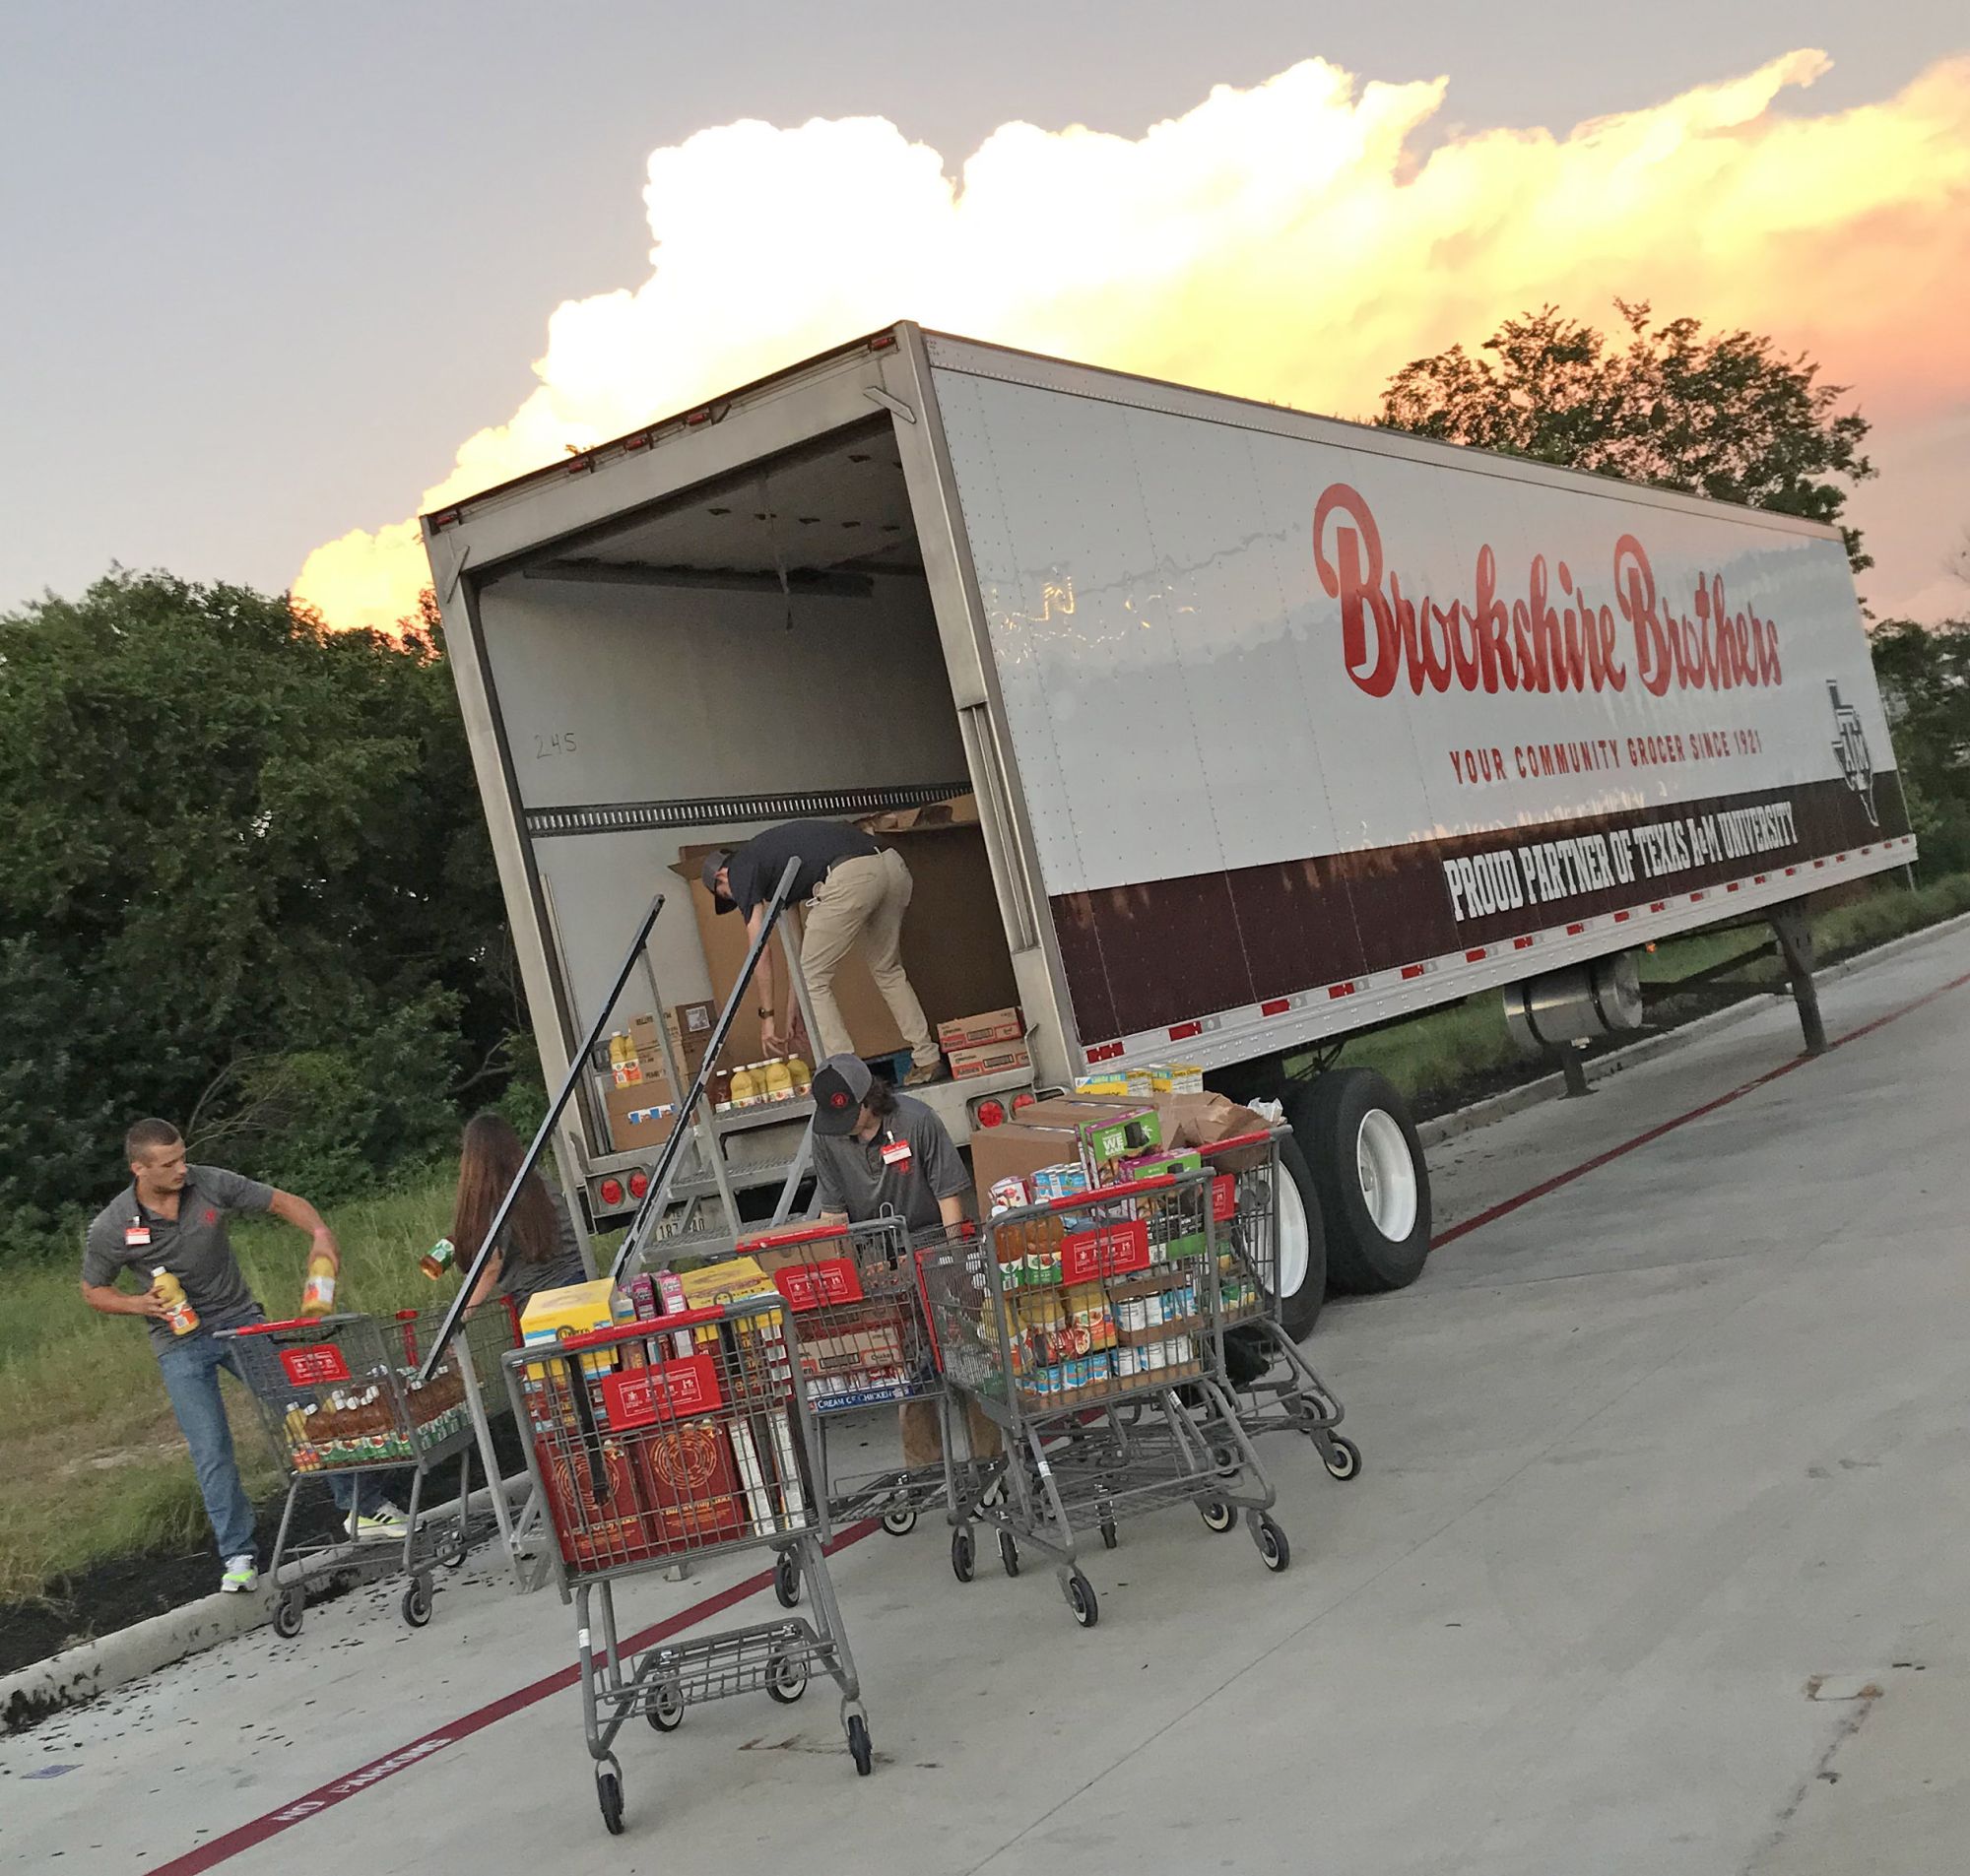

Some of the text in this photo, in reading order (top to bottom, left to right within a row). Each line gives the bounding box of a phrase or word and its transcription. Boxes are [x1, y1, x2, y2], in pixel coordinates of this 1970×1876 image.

[1313, 483, 1783, 698] Brookshire Brothers
[534, 733, 576, 759] 245
[1450, 729, 1763, 784] YOUR COMMUNITY GROCER SINCE 1921
[1443, 801, 1798, 922] PROUD PARTNER OF TEXAS A&M UNIVERSITY
[817, 1396, 845, 1409] CREAM
[271, 1737, 452, 1822] NO PARKING
